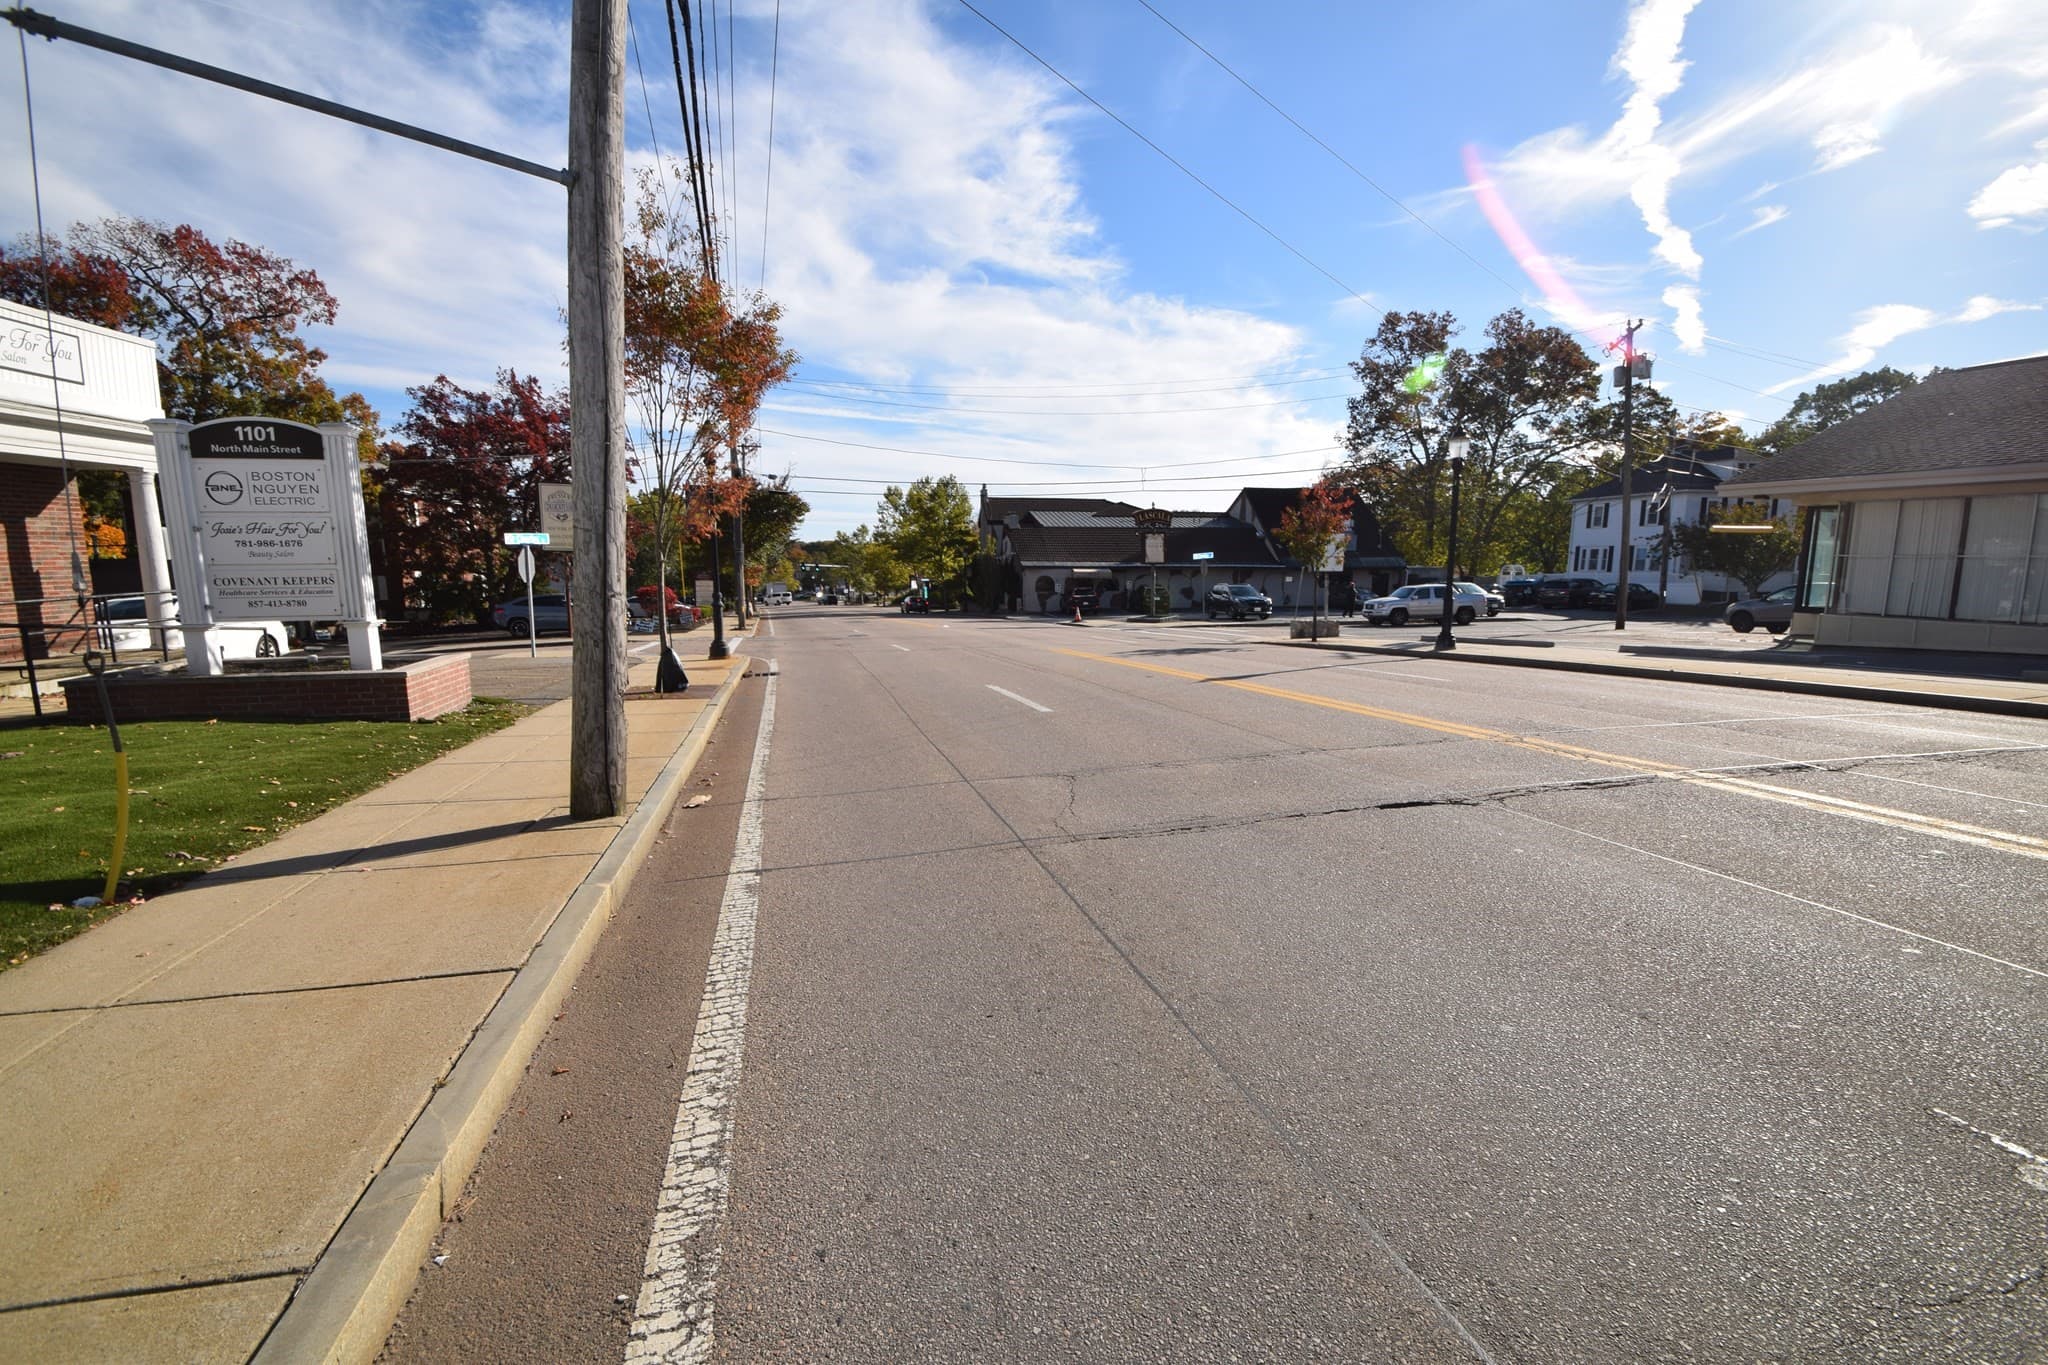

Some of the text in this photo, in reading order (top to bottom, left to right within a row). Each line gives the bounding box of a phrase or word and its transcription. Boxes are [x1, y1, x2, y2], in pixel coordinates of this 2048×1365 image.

[10, 328, 73, 363] For You
[1, 350, 27, 365] Salon
[234, 425, 276, 442] 1101
[210, 444, 302, 454] North Main Street
[251, 471, 316, 482] BOSTON
[252, 484, 320, 494] NGUYEN
[254, 497, 316, 506] ELECTRIC
[210, 520, 327, 539] Josie's Hair For You!
[234, 540, 303, 548] 781-986-1676
[247, 550, 296, 560] Beauty Salon
[213, 576, 336, 587] COVENANT KEEPERS
[218, 588, 258, 597] Healthcare
[259, 588, 288, 596] Services
[297, 587, 334, 595] Education
[247, 599, 308, 608] 857-413-8780
